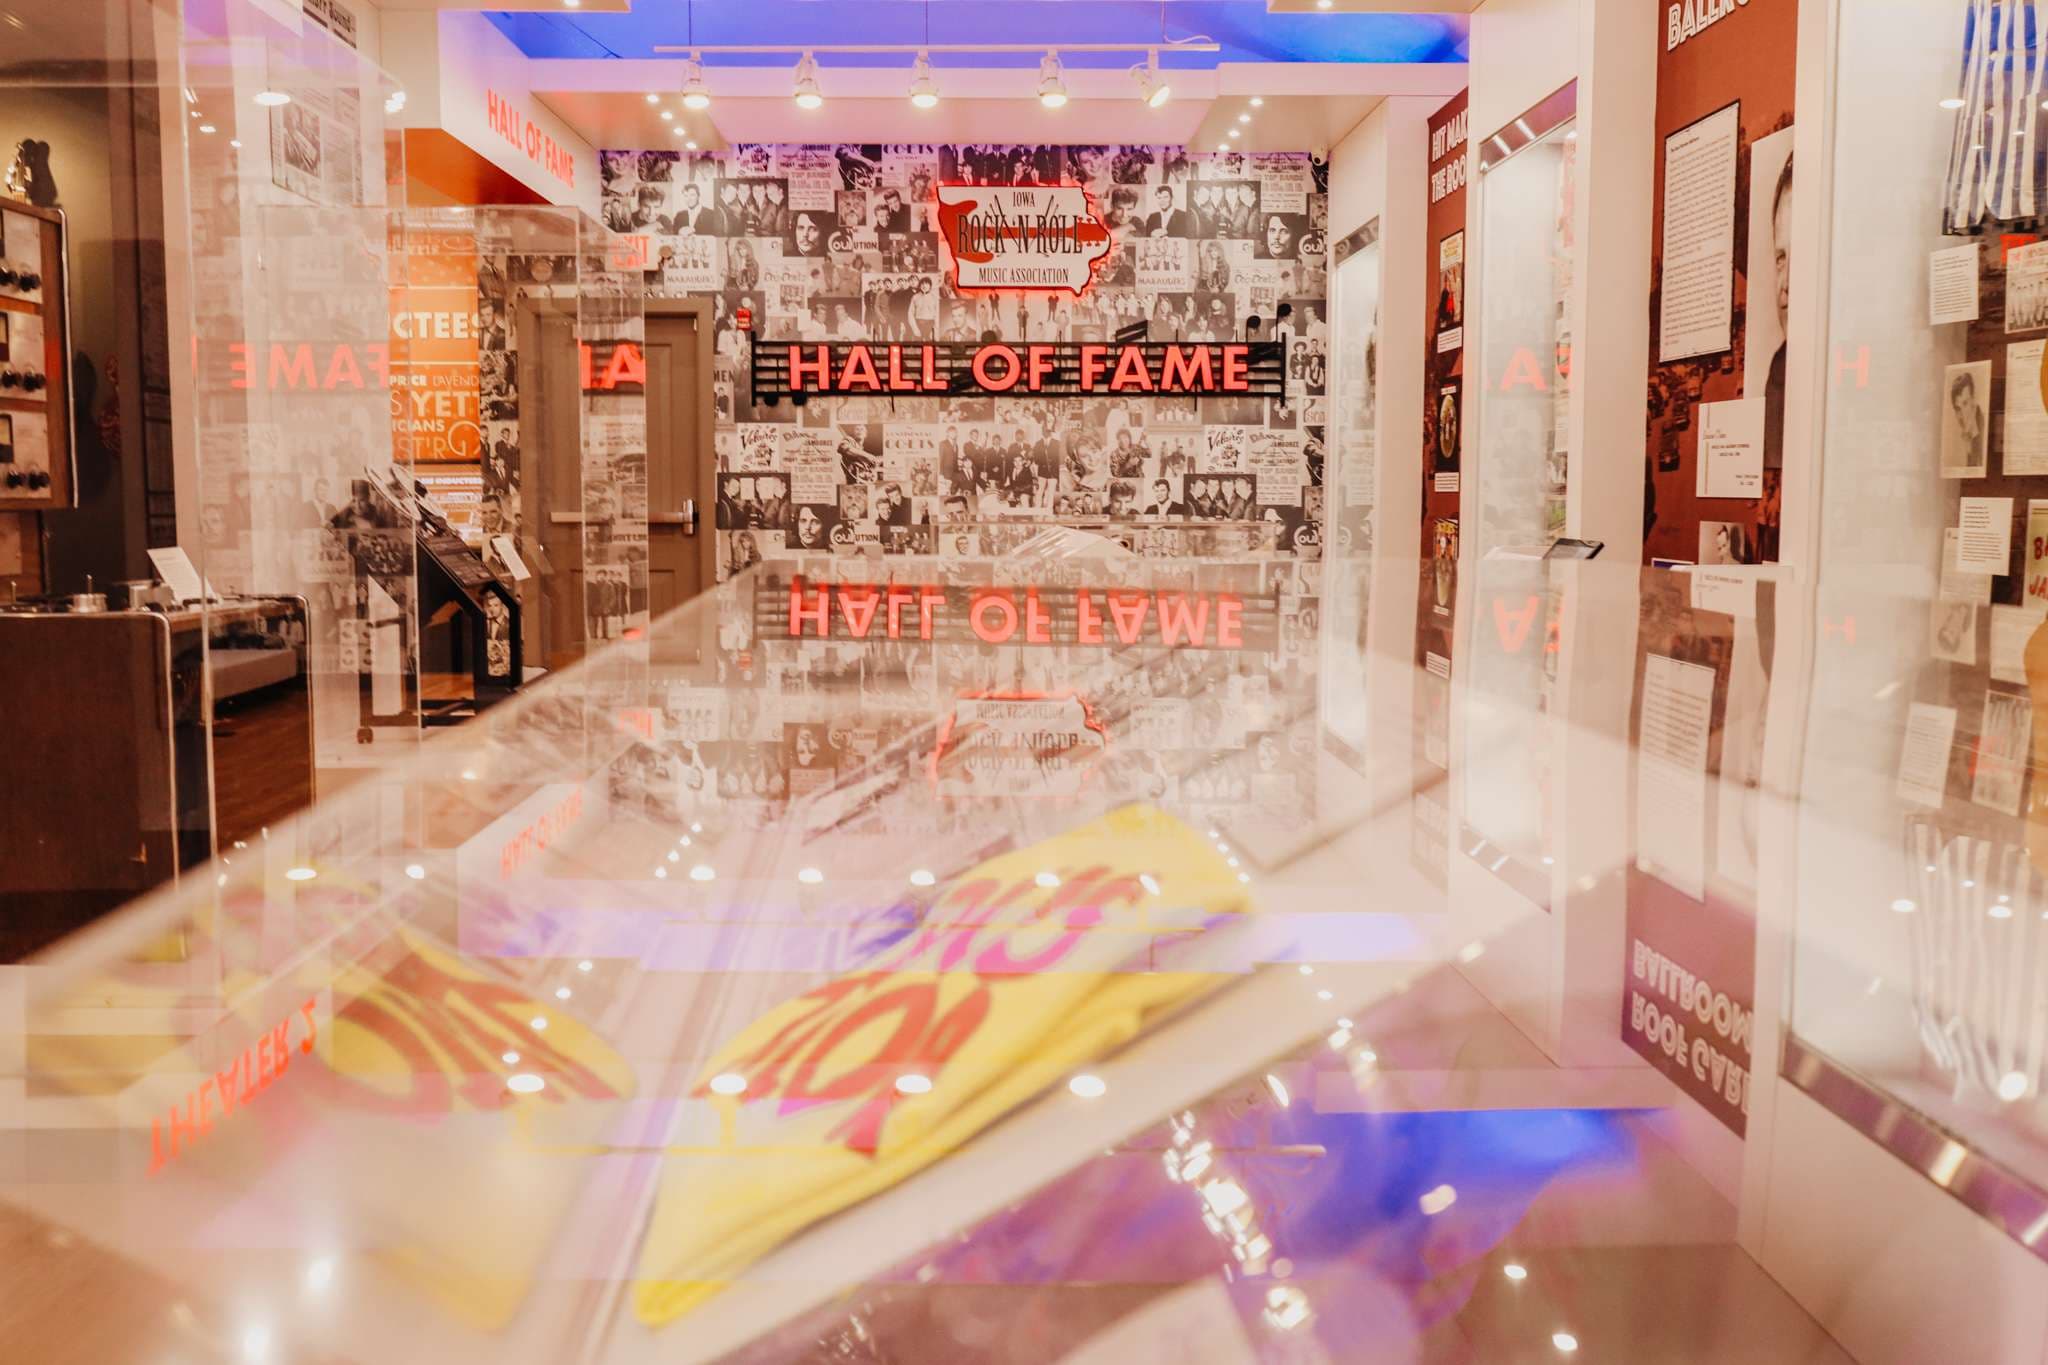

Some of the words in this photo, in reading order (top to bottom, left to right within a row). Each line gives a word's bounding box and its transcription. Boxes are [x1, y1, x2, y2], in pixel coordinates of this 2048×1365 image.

[1667, 0, 1750, 51] BALL
[487, 88, 523, 150] HALL
[526, 120, 542, 163] OF
[544, 136, 574, 189] FAME
[1432, 124, 1446, 162] HIT
[1012, 191, 1036, 208] IOWA
[1432, 167, 1446, 203] THE
[958, 214, 1007, 254] ROCK
[1036, 214, 1083, 254] ROLL
[978, 267, 1008, 283] MUSIC
[1009, 267, 1069, 284] ASSOCIATION
[389, 375, 427, 386] PRICE
[788, 344, 948, 391] HALL
[971, 343, 1055, 392] OF
[1080, 344, 1250, 391] FAME
